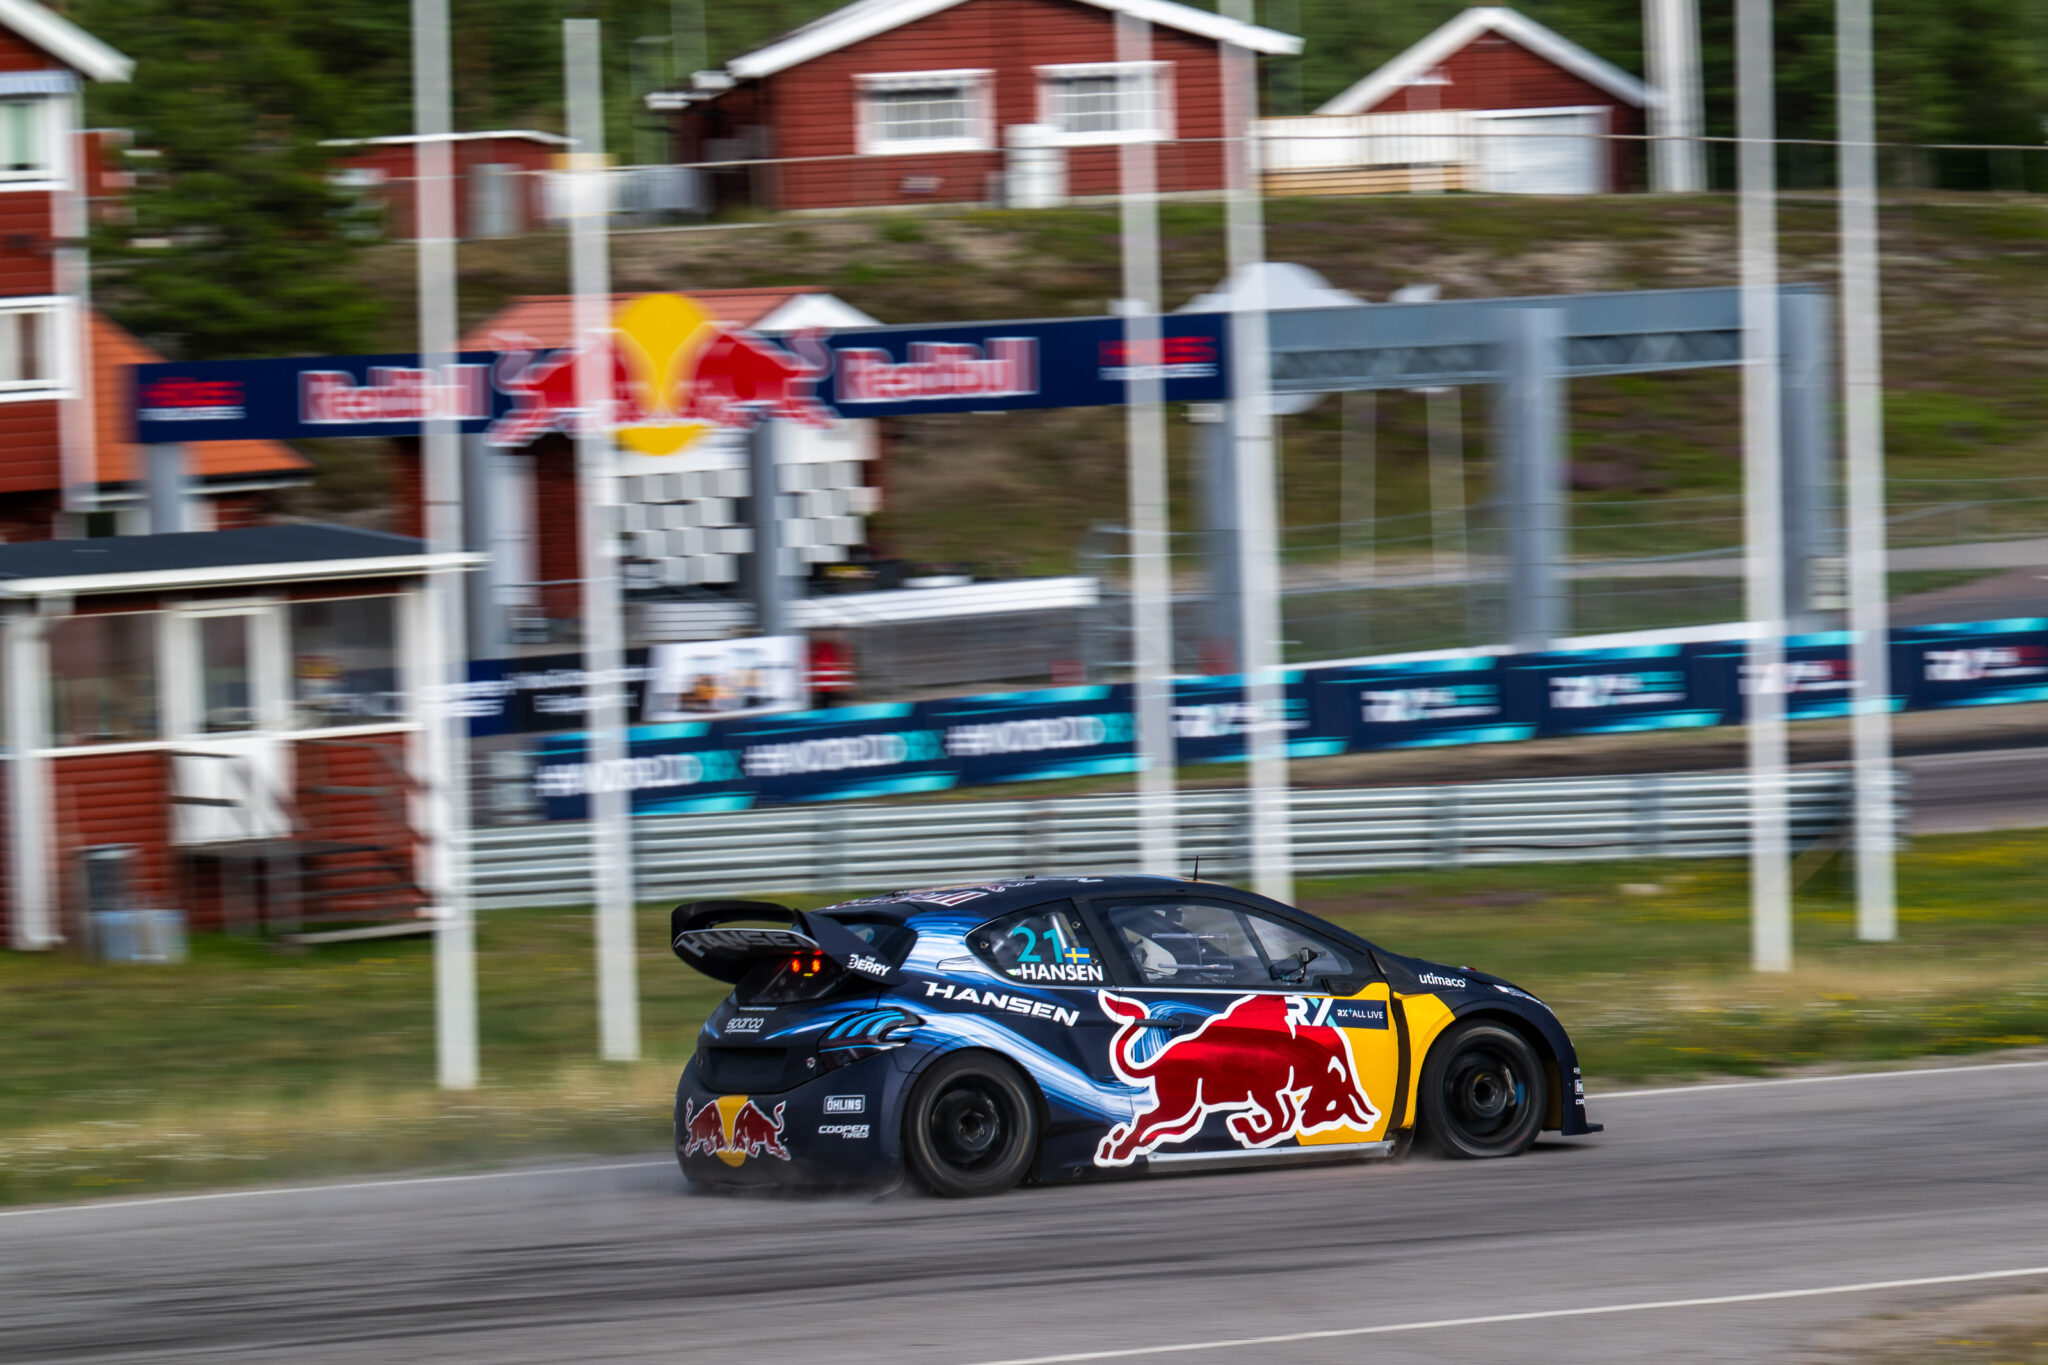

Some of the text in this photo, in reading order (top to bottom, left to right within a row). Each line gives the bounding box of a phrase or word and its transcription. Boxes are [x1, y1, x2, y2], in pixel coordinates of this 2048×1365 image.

[1012, 926, 1063, 963] 21
[846, 953, 892, 976] BERRY
[1021, 963, 1104, 981] HANSEN
[1418, 972, 1466, 988] utimaco
[922, 981, 1080, 1028] HANSEN
[1367, 1010, 1384, 1019] LIVE
[725, 1017, 764, 1033] sparco
[818, 1124, 870, 1134] COOPER
